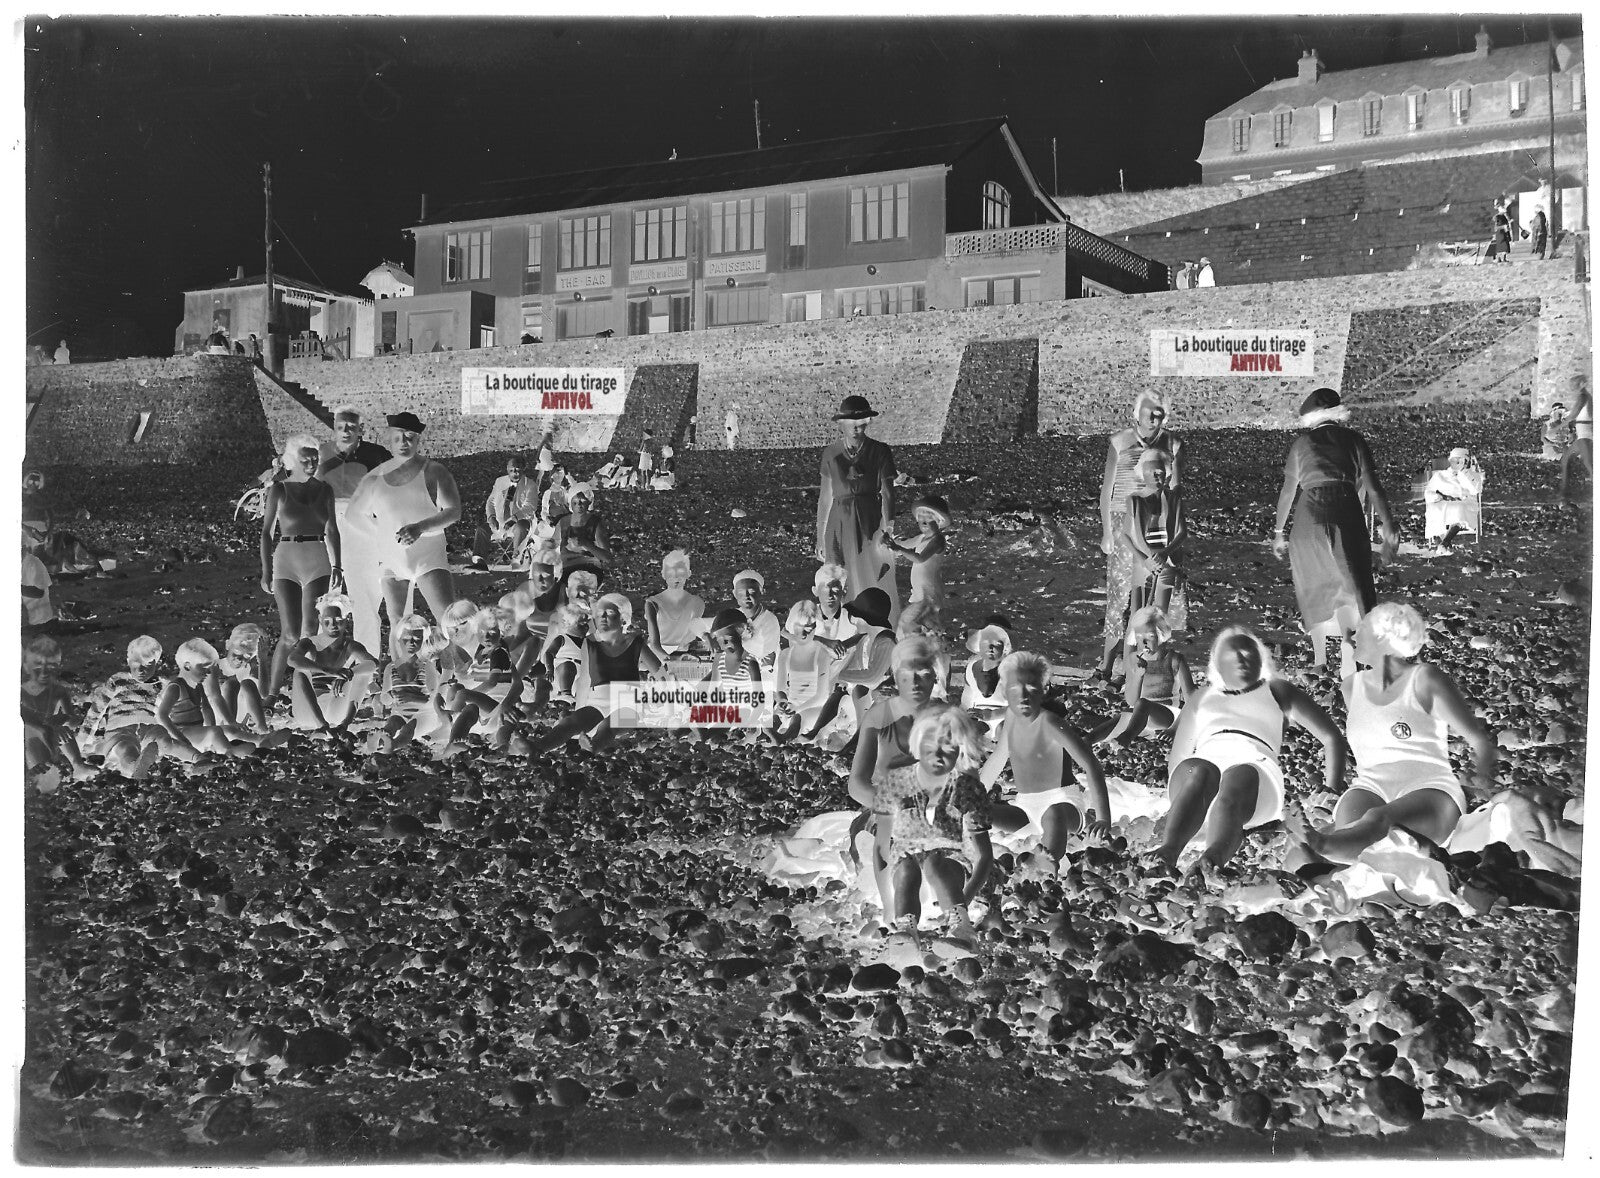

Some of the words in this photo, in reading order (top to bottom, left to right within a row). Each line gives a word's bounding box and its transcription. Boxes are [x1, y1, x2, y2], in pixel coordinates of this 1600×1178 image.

[709, 260, 761, 274] PATISSERIE
[560, 277, 580, 288] THE
[585, 274, 606, 286] BAR
